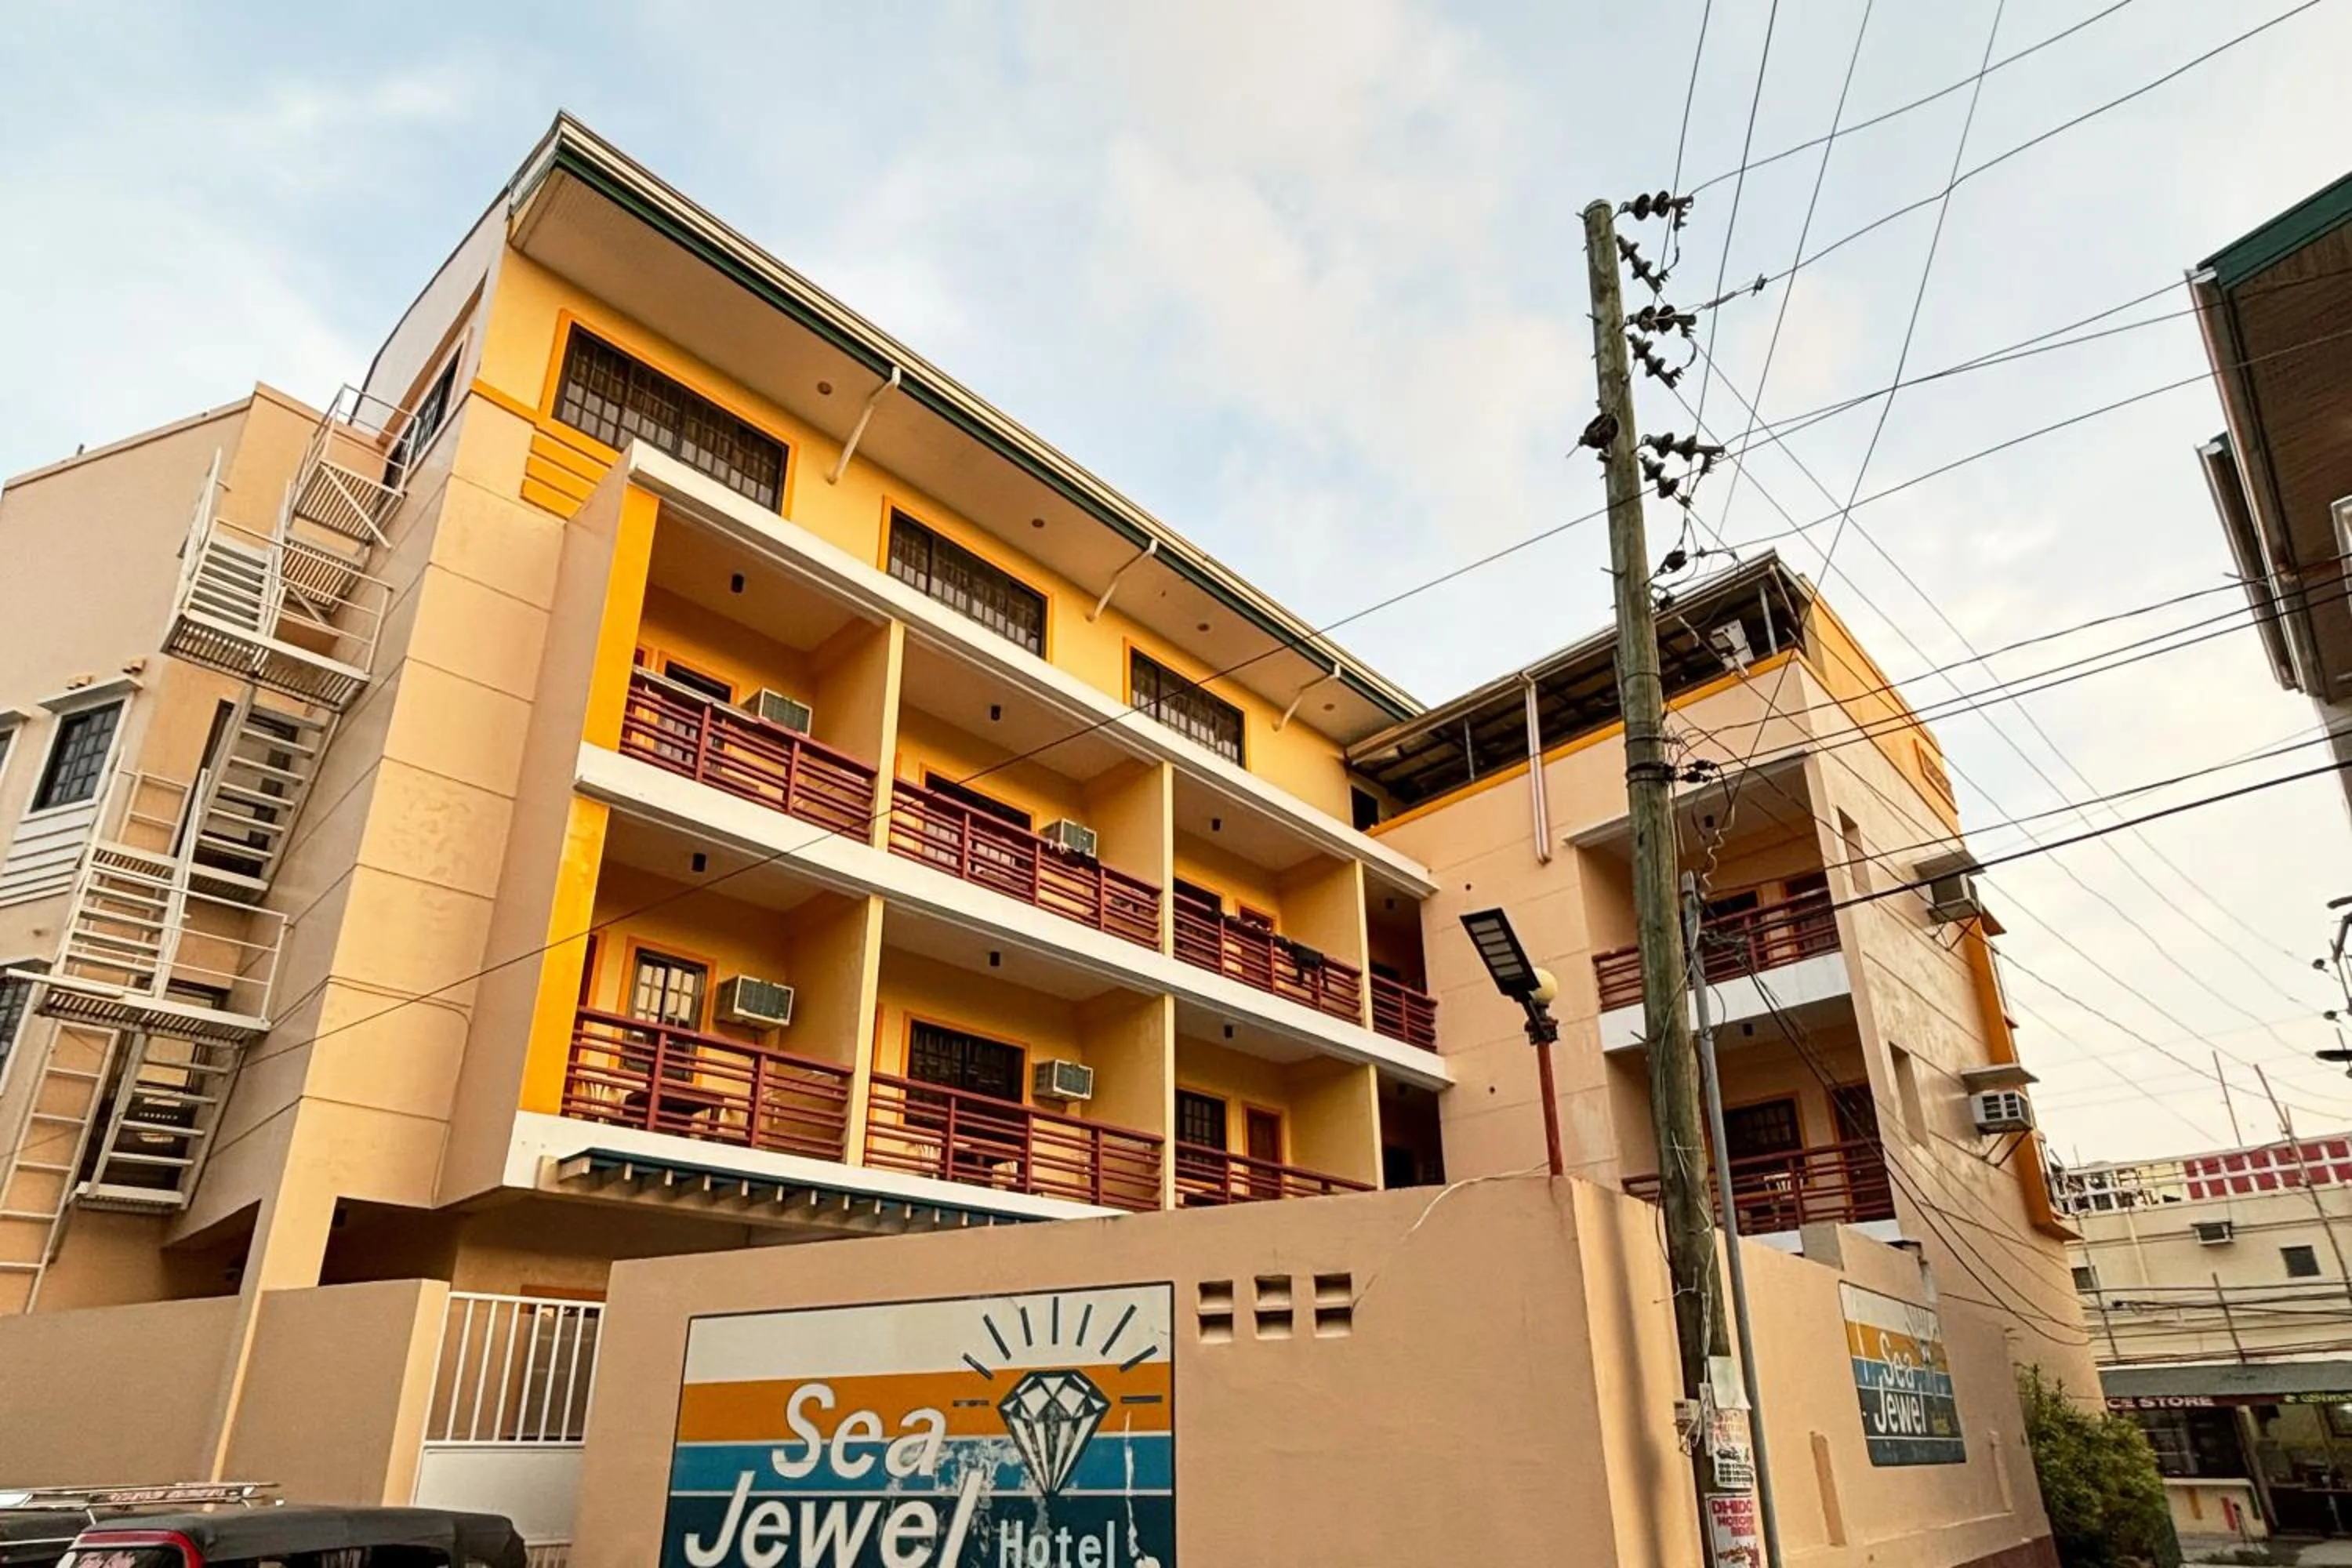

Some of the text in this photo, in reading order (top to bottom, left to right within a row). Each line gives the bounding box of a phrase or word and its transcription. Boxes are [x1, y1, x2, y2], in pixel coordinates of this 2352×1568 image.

[1879, 1332, 1915, 1388] Sea
[771, 1382, 946, 1479] Sea
[1874, 1374, 1928, 1435] Jewel
[2139, 1396, 2215, 1408] STORE
[684, 1468, 1116, 1568] Jewel Hotel
